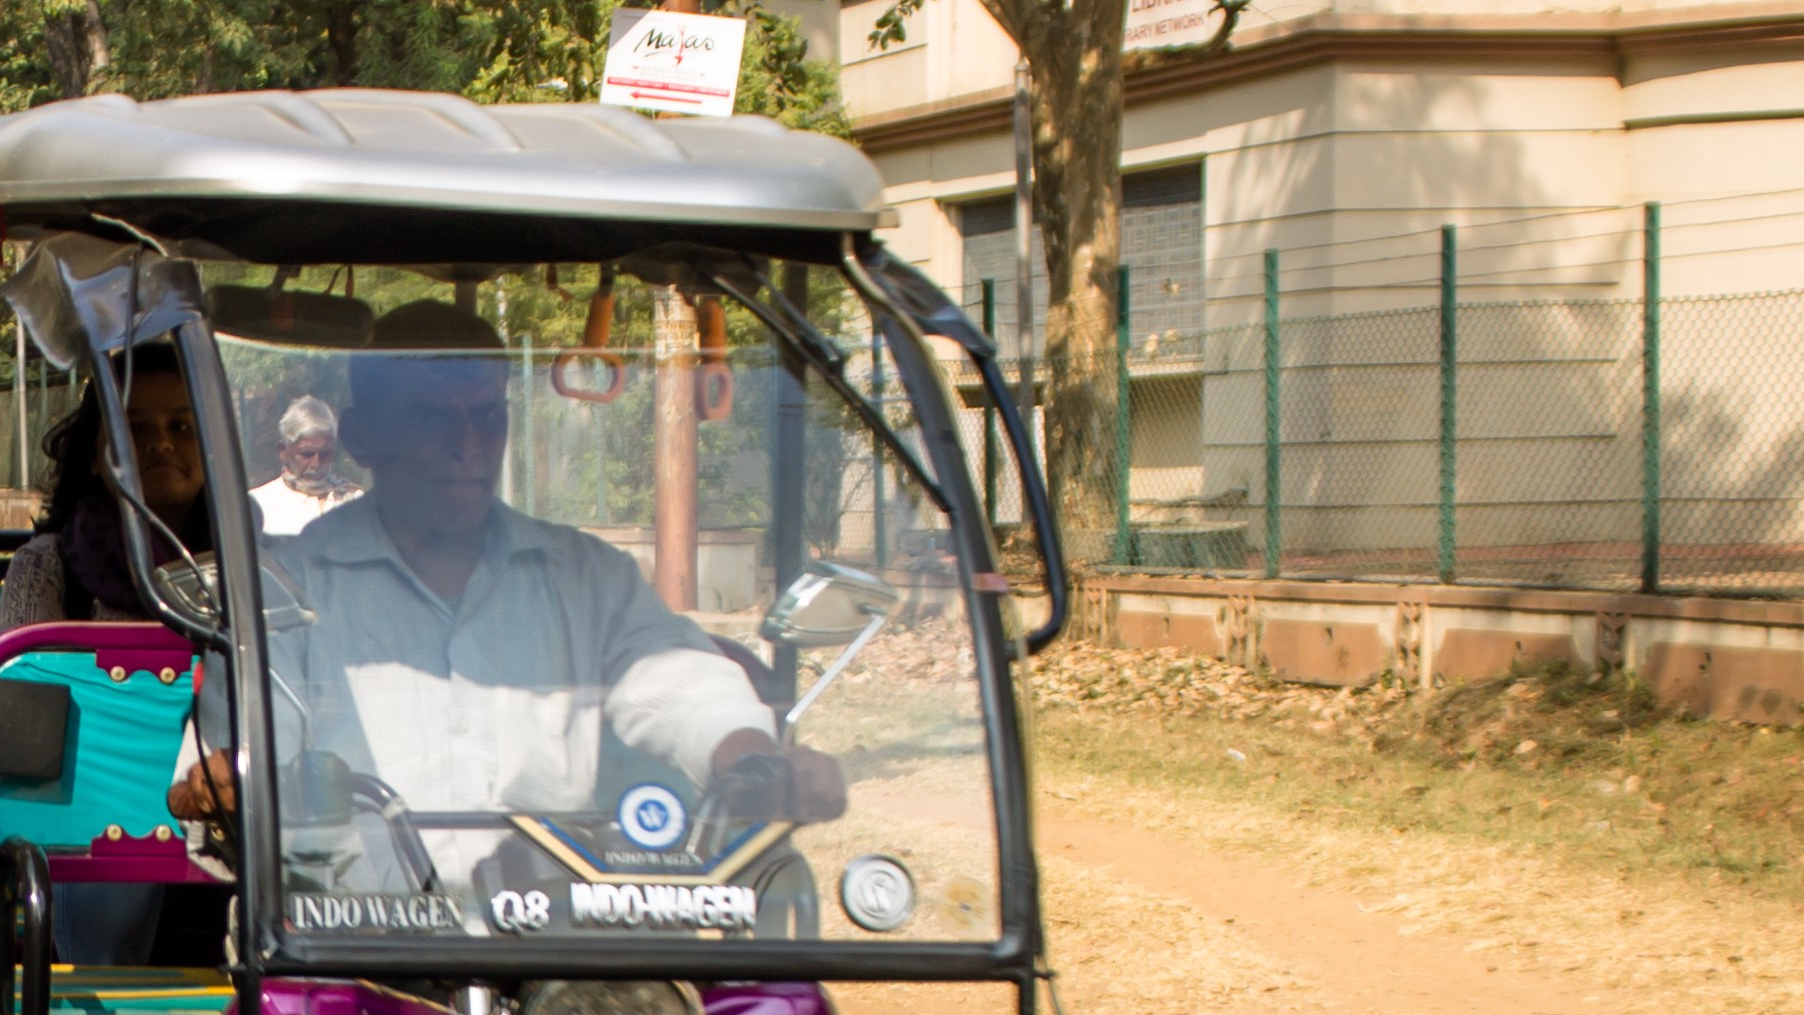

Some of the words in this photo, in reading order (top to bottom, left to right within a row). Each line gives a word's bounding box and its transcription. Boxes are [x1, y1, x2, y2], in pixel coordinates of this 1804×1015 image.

[1154, 12, 1205, 35] NETWORK
[294, 895, 362, 928] INDO
[365, 895, 466, 928] WAGEN
[491, 889, 550, 931] Q8
